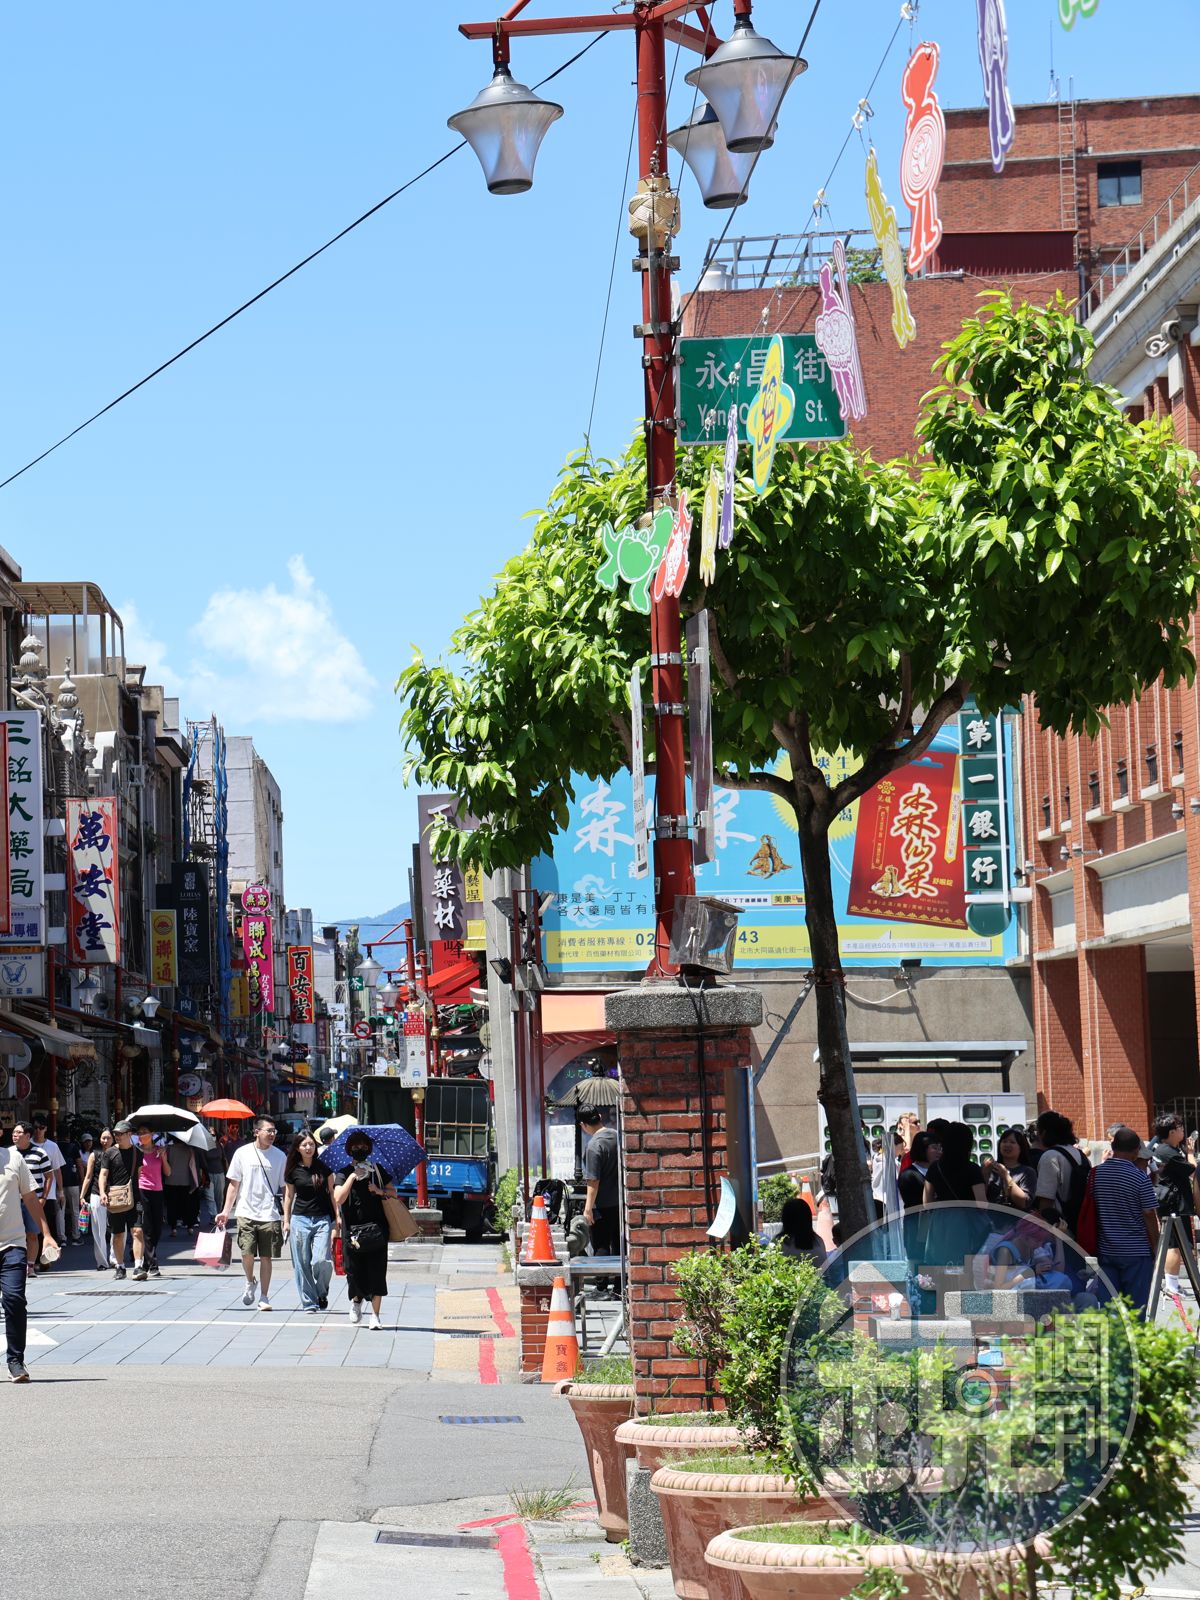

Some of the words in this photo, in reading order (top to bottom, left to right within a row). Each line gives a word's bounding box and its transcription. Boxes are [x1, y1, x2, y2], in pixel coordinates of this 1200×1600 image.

[695, 346, 833, 392] 永昌街
[805, 399, 828, 423] St.
[5, 719, 35, 898] 三銘大藥局
[964, 718, 999, 886] 第一銀行
[72, 811, 112, 951] 萬安堂
[427, 803, 458, 931] 百藥材
[634, 932, 656, 946] 02
[738, 930, 759, 944] 43
[261, 973, 271, 1006] からすみ
[291, 950, 311, 1021] 百安堂
[430, 1164, 452, 1177] 312
[555, 1343, 568, 1373] 寶鑫
